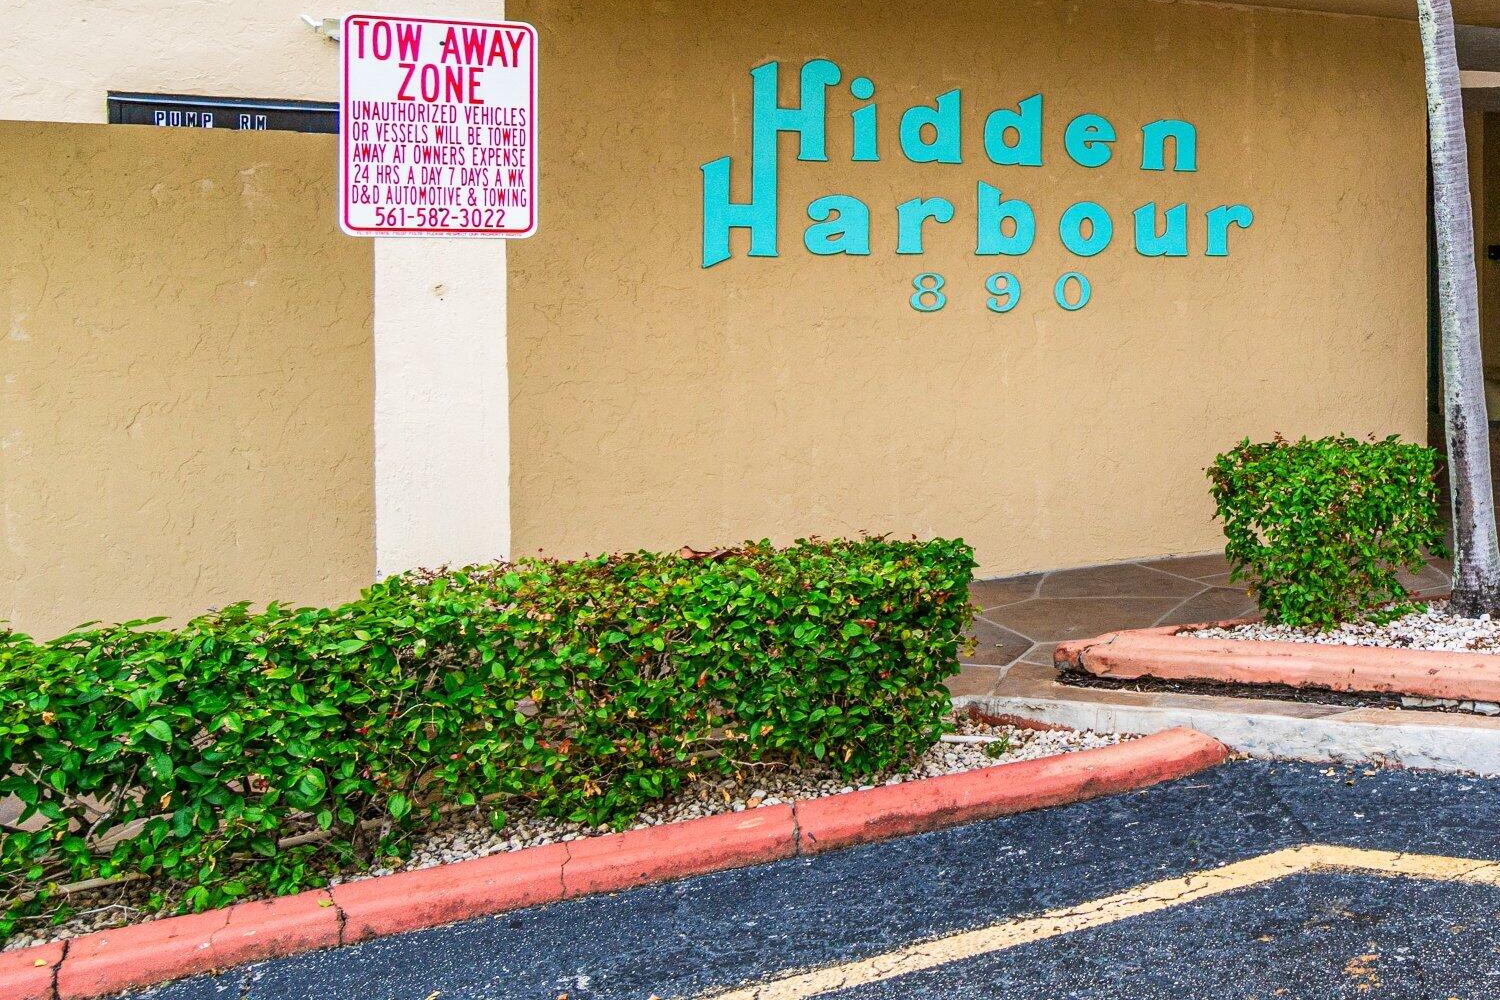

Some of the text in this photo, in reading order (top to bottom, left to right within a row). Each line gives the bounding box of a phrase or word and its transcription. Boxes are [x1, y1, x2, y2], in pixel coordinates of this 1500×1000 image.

[353, 21, 525, 67] TOW AWAY
[398, 63, 484, 104] ZONE
[155, 111, 266, 130] PUMP RM
[352, 101, 526, 126] UNAUTHORIZED VEHICLES
[749, 58, 1198, 172] Hidden
[352, 122, 526, 147] OR VESSELS WILL BE TOWED
[352, 143, 526, 167] AWAY AT OWNERS EXPENSE
[354, 164, 524, 187] 24 HRS A DAY 7 DAYS A WK
[352, 185, 526, 207] D&D AUTOMOTIVE & TOWING
[375, 207, 506, 227] 561-582-3022
[700, 155, 1254, 269] Harbour
